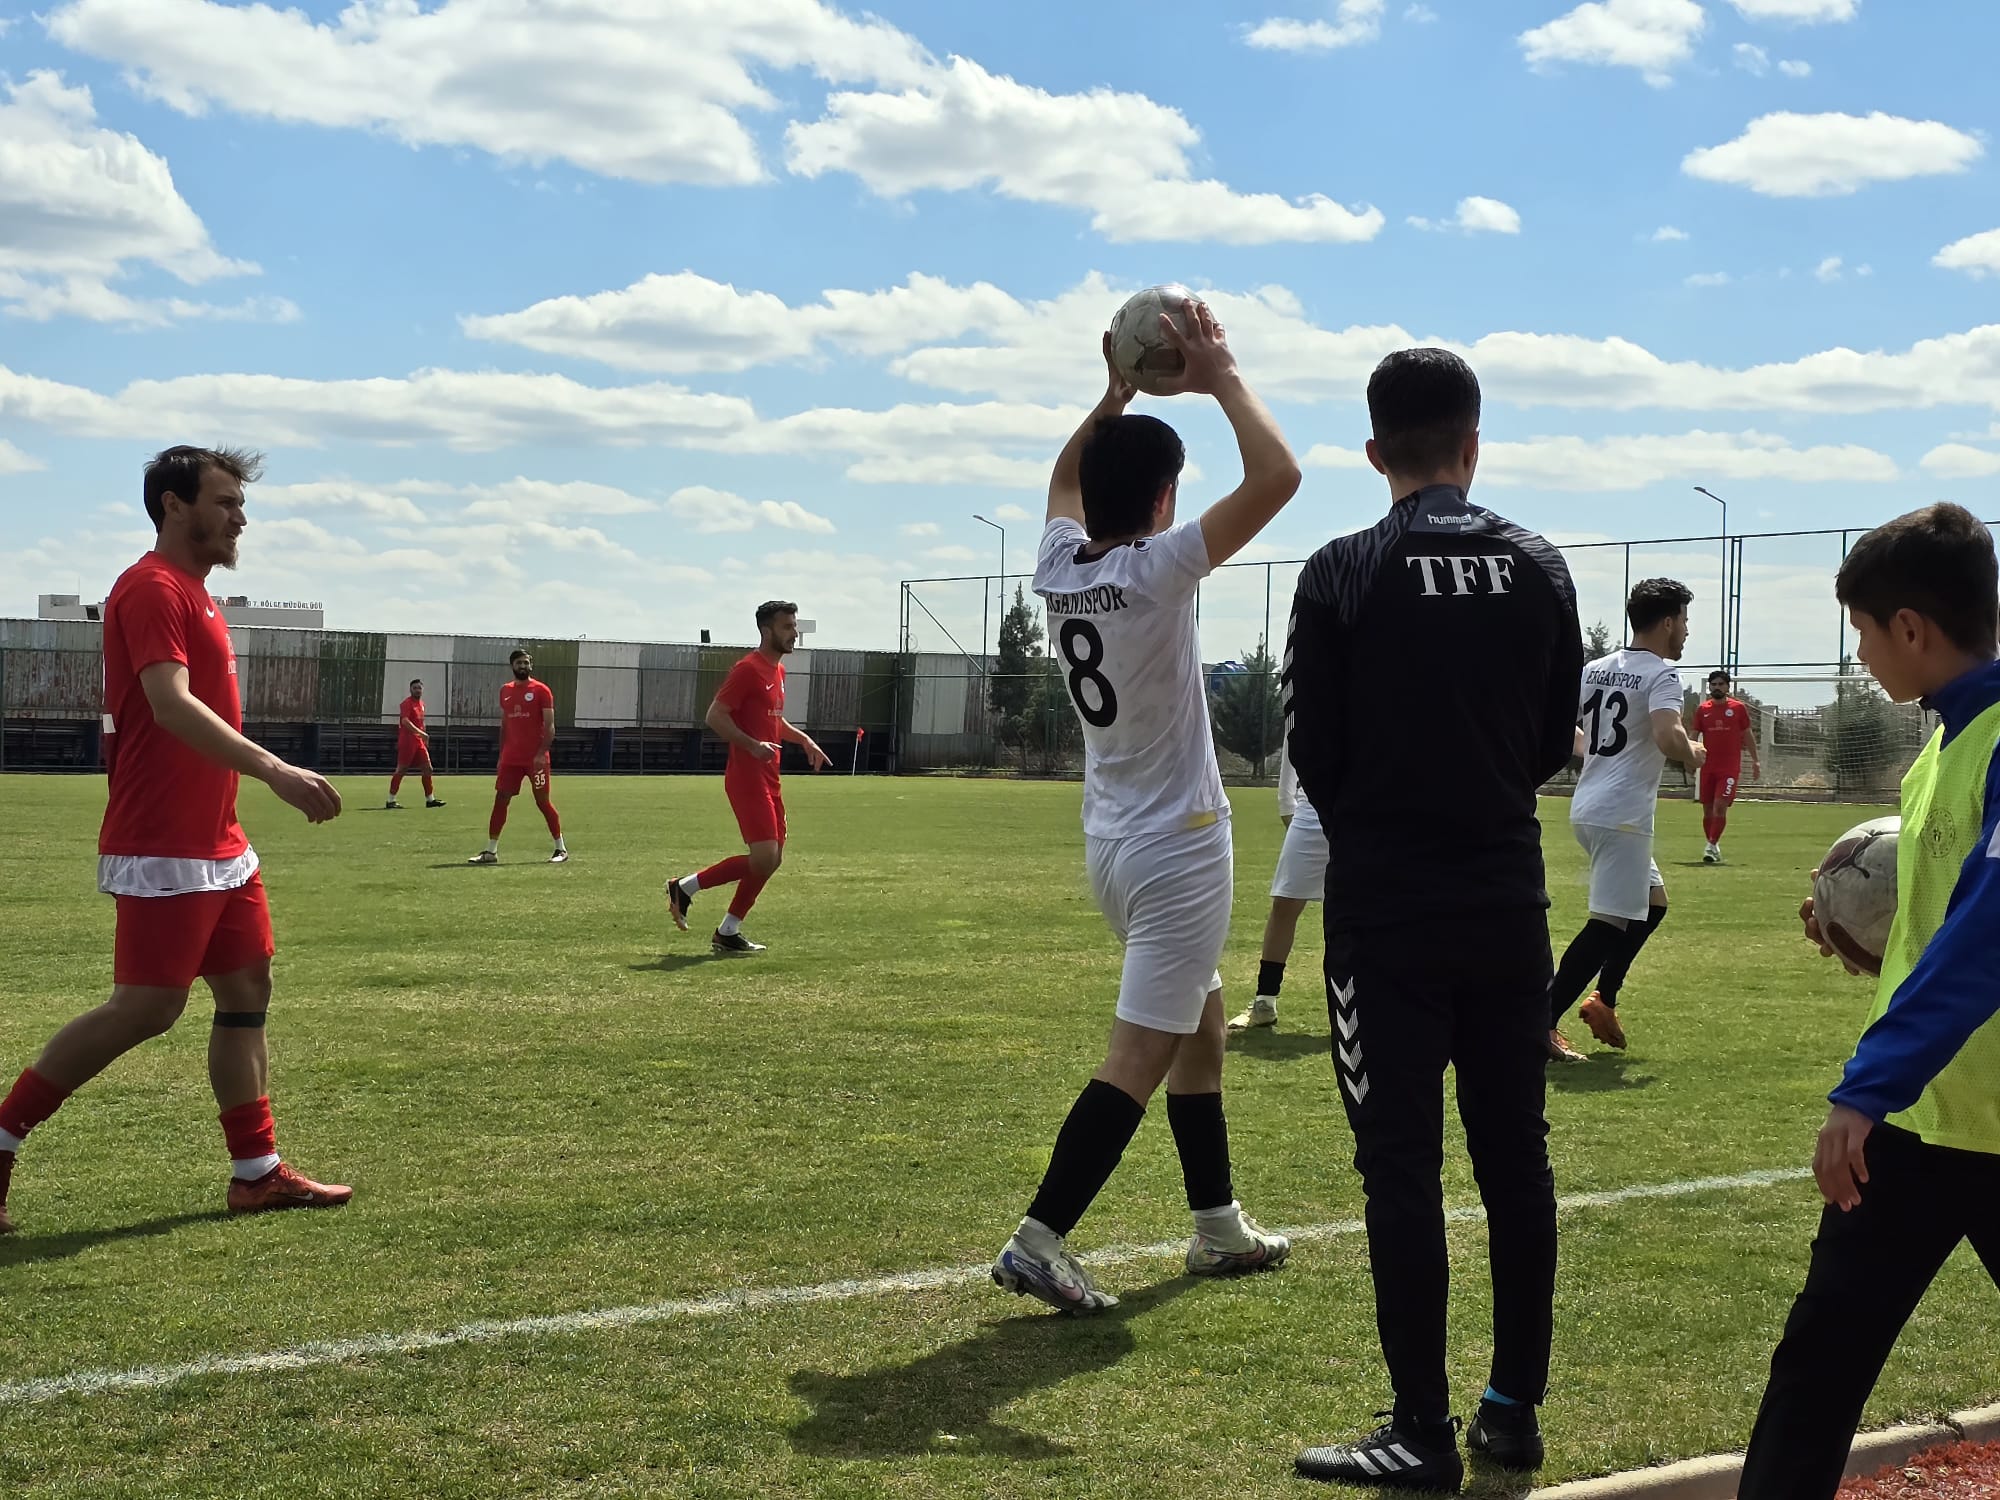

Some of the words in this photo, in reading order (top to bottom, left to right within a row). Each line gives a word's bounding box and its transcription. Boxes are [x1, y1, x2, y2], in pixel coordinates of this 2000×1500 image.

[1427, 513, 1472, 525] hummel
[1406, 554, 1515, 596] TFF
[1060, 618, 1118, 728] 8
[1583, 688, 1628, 757] 13
[535, 774, 546, 786] 35
